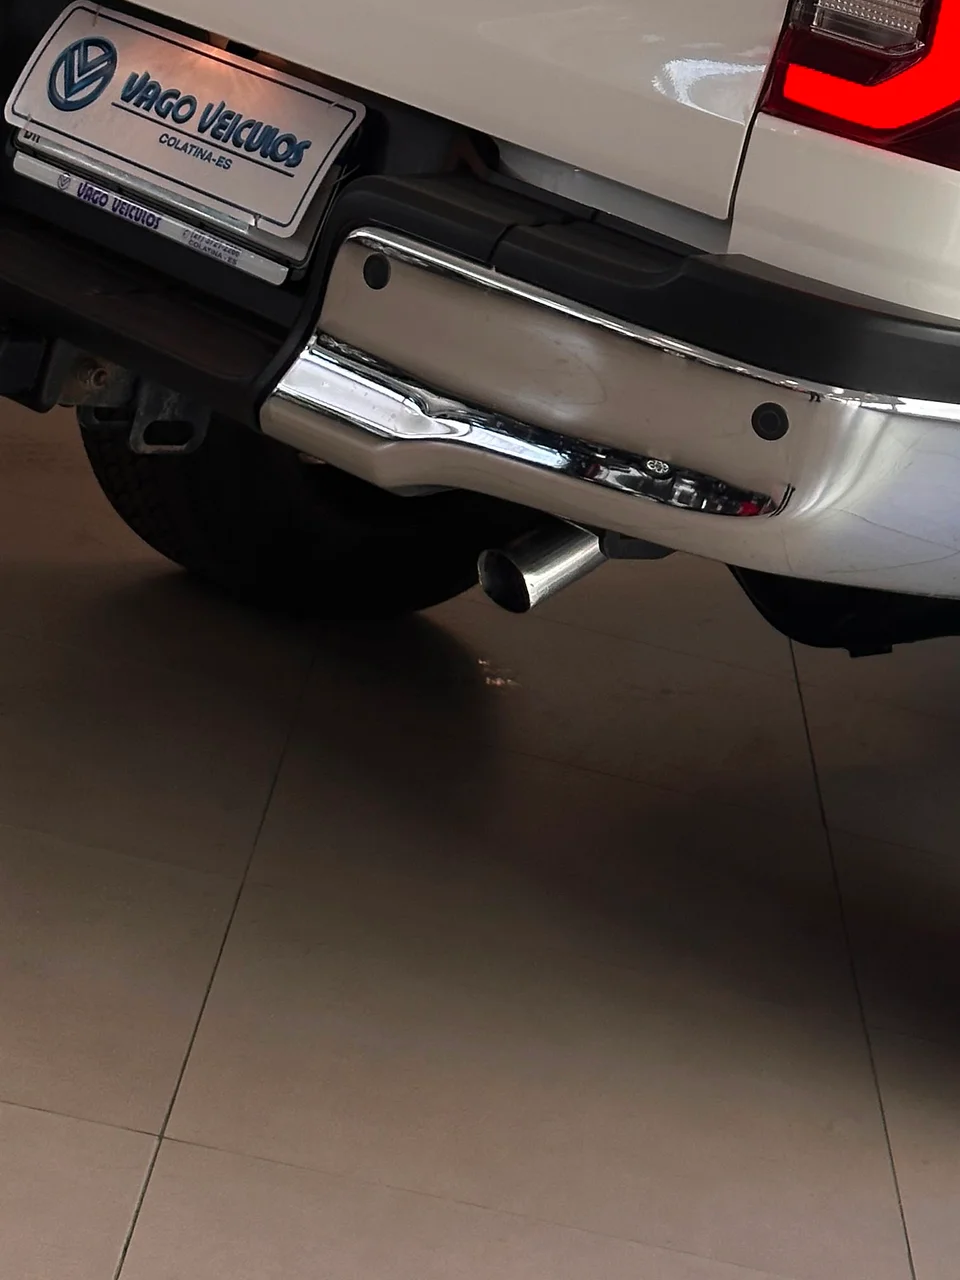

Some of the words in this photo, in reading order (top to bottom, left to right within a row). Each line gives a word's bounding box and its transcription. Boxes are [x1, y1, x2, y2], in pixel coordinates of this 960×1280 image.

[120, 70, 198, 124] VAGO
[197, 101, 312, 168] VEICULOS
[158, 133, 233, 170] COLATINA-ES
[77, 181, 109, 207] VAGO
[111, 197, 162, 229] VEICULOS
